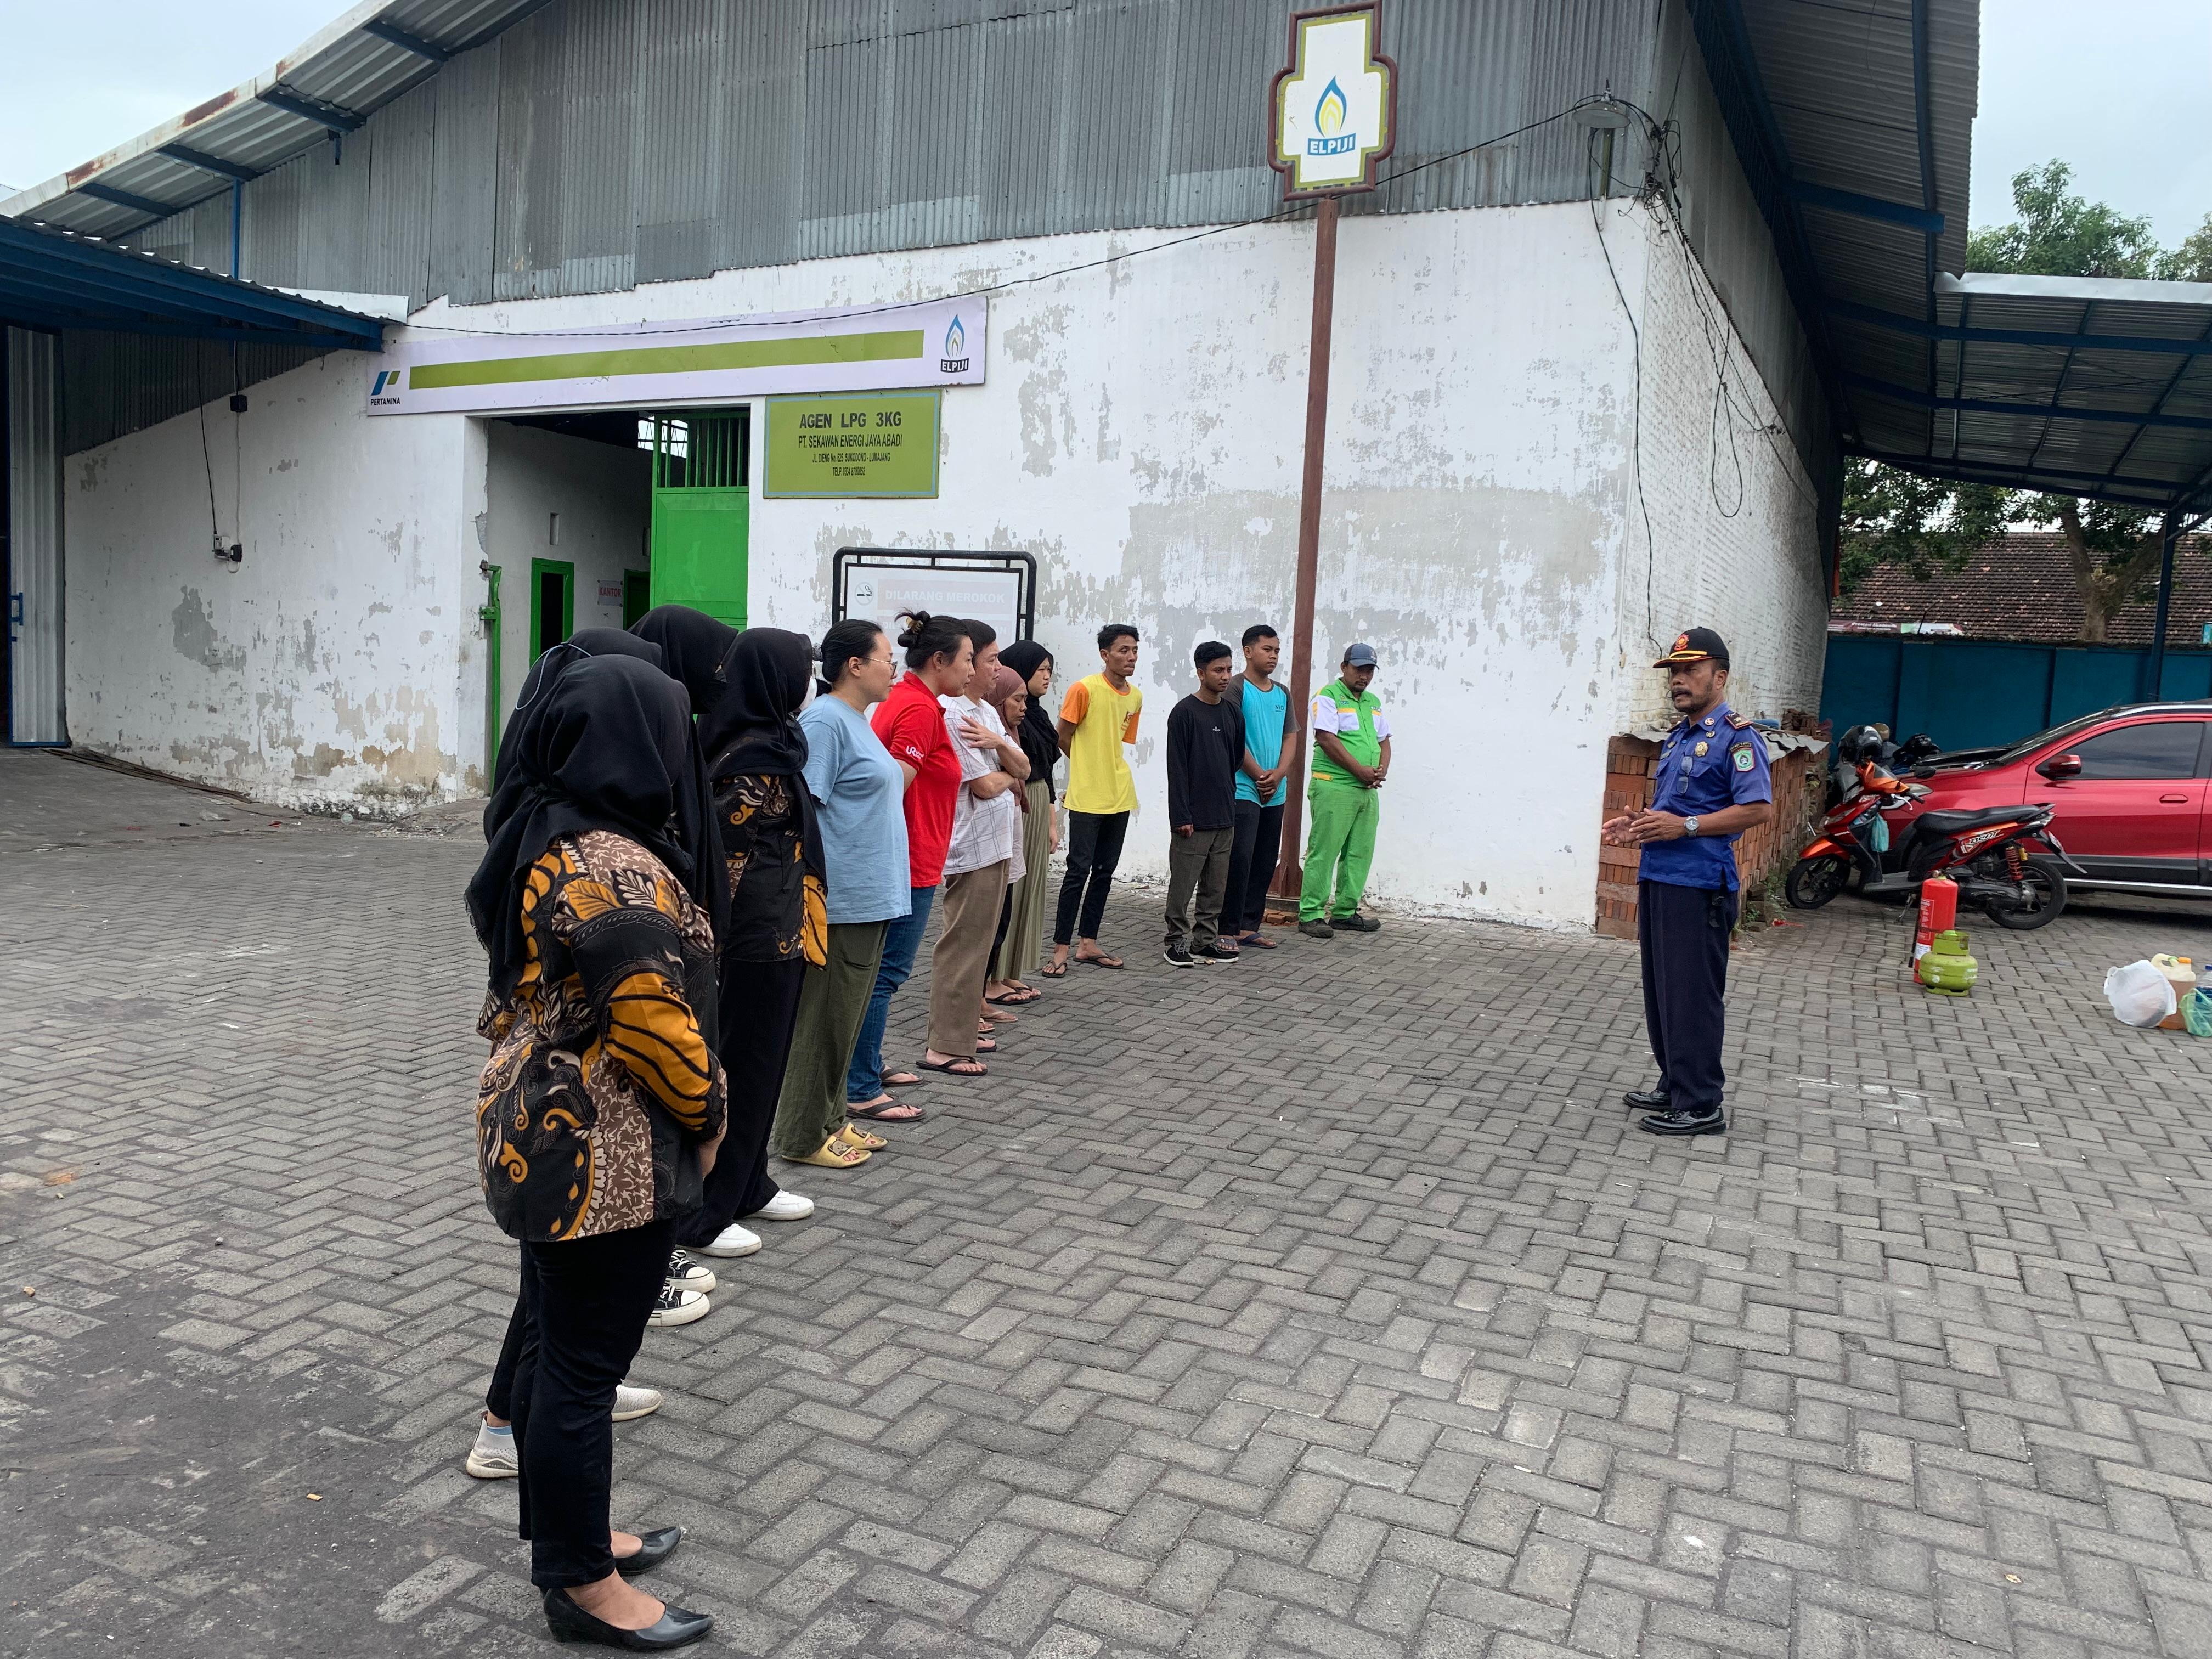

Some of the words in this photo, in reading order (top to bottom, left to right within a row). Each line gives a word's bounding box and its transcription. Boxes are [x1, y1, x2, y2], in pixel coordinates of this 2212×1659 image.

[1310, 136, 1353, 154] ELPIJI
[941, 359, 968, 371] ELPIJI
[370, 397, 400, 406] PERTAMINA
[799, 414, 832, 428] AGEN
[840, 413, 867, 428] LPG
[876, 411, 902, 427] 3KG
[798, 435, 807, 448] PT.
[809, 435, 839, 448] SEKAWAN
[840, 434, 864, 447] ENERGI
[865, 434, 881, 447] JAYA
[882, 433, 902, 447] ABADI
[819, 453, 830, 462] DIENG
[845, 453, 866, 462] SUKODONO
[869, 452, 890, 462] LUMAJANG
[599, 587, 622, 597] KANTOR
[885, 590, 943, 601] DILARANG
[946, 591, 1005, 604] MEROKOK
